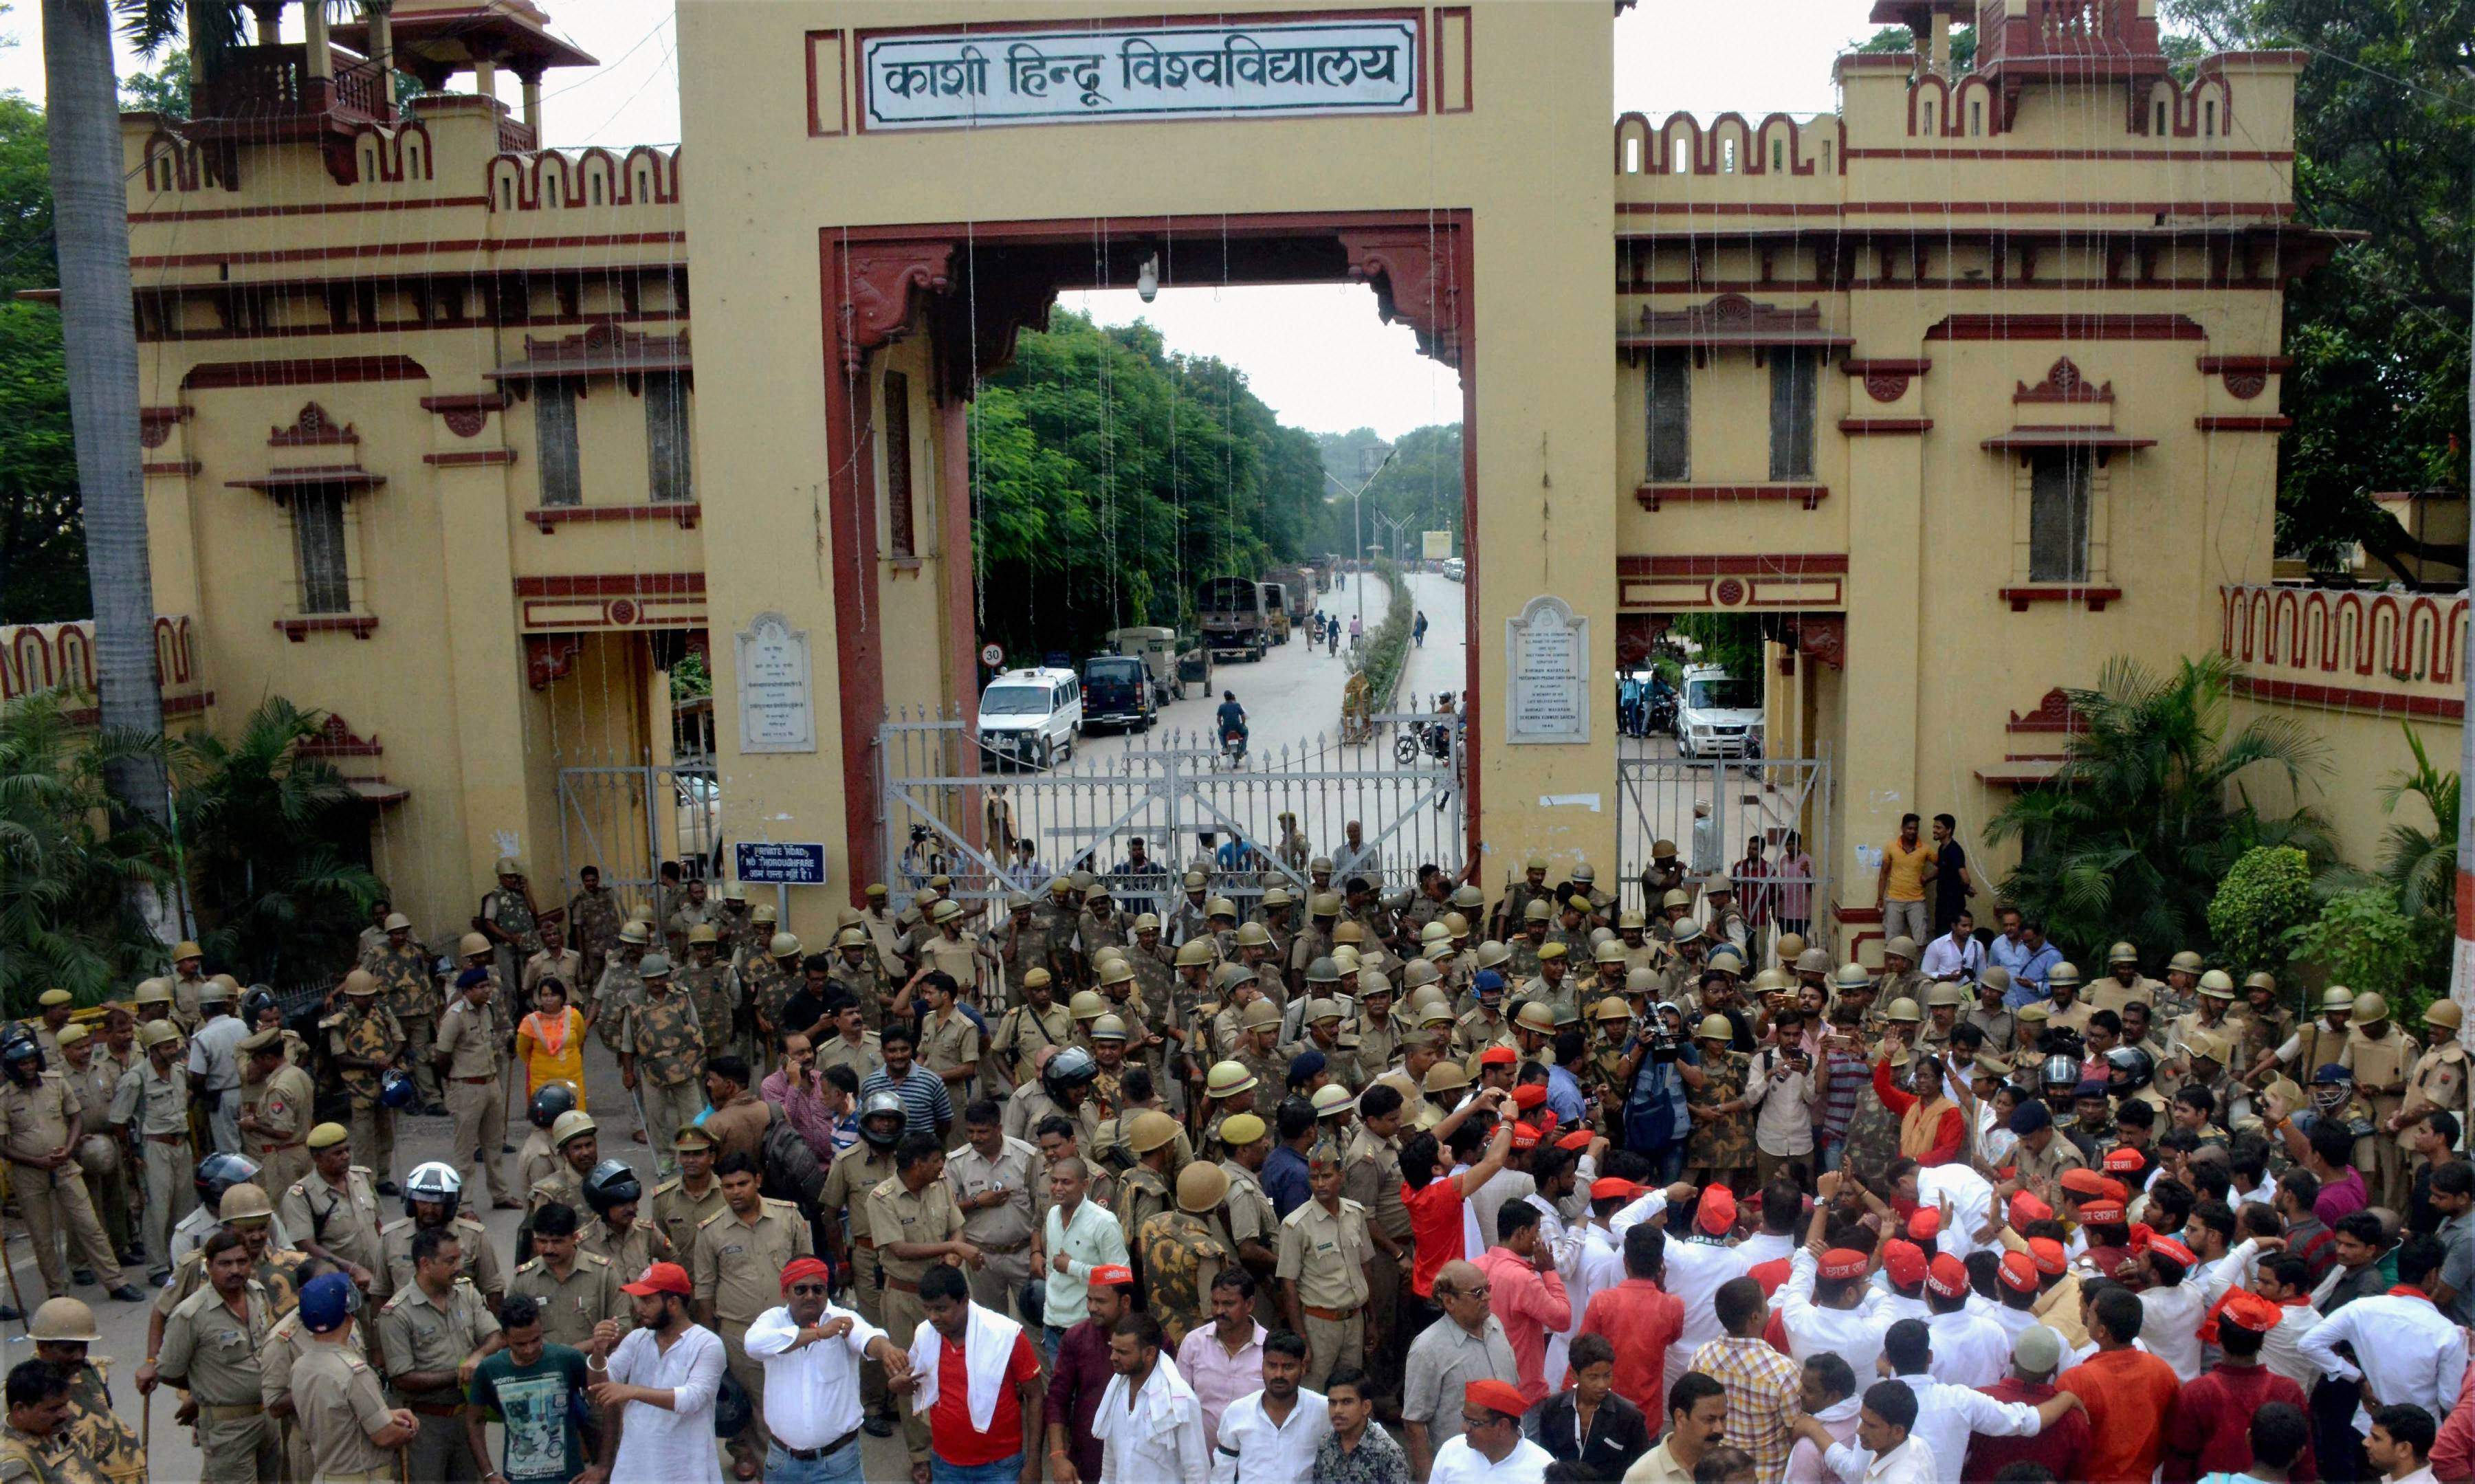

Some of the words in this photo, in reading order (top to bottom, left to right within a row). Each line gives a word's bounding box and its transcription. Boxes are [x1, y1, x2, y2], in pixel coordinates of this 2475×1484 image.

[881, 45, 989, 100] काशी
[1004, 43, 1112, 107] हिन्दू
[1116, 34, 1400, 91] विश्वविद्यालय
[986, 650, 999, 661] 30
[754, 847, 782, 856] PRIVATE
[784, 847, 804, 856] ROAD
[746, 858, 756, 866] NO
[758, 858, 815, 867] THOROUGHFARE
[749, 870, 764, 878] आम
[492, 1376, 516, 1385] NORTH
